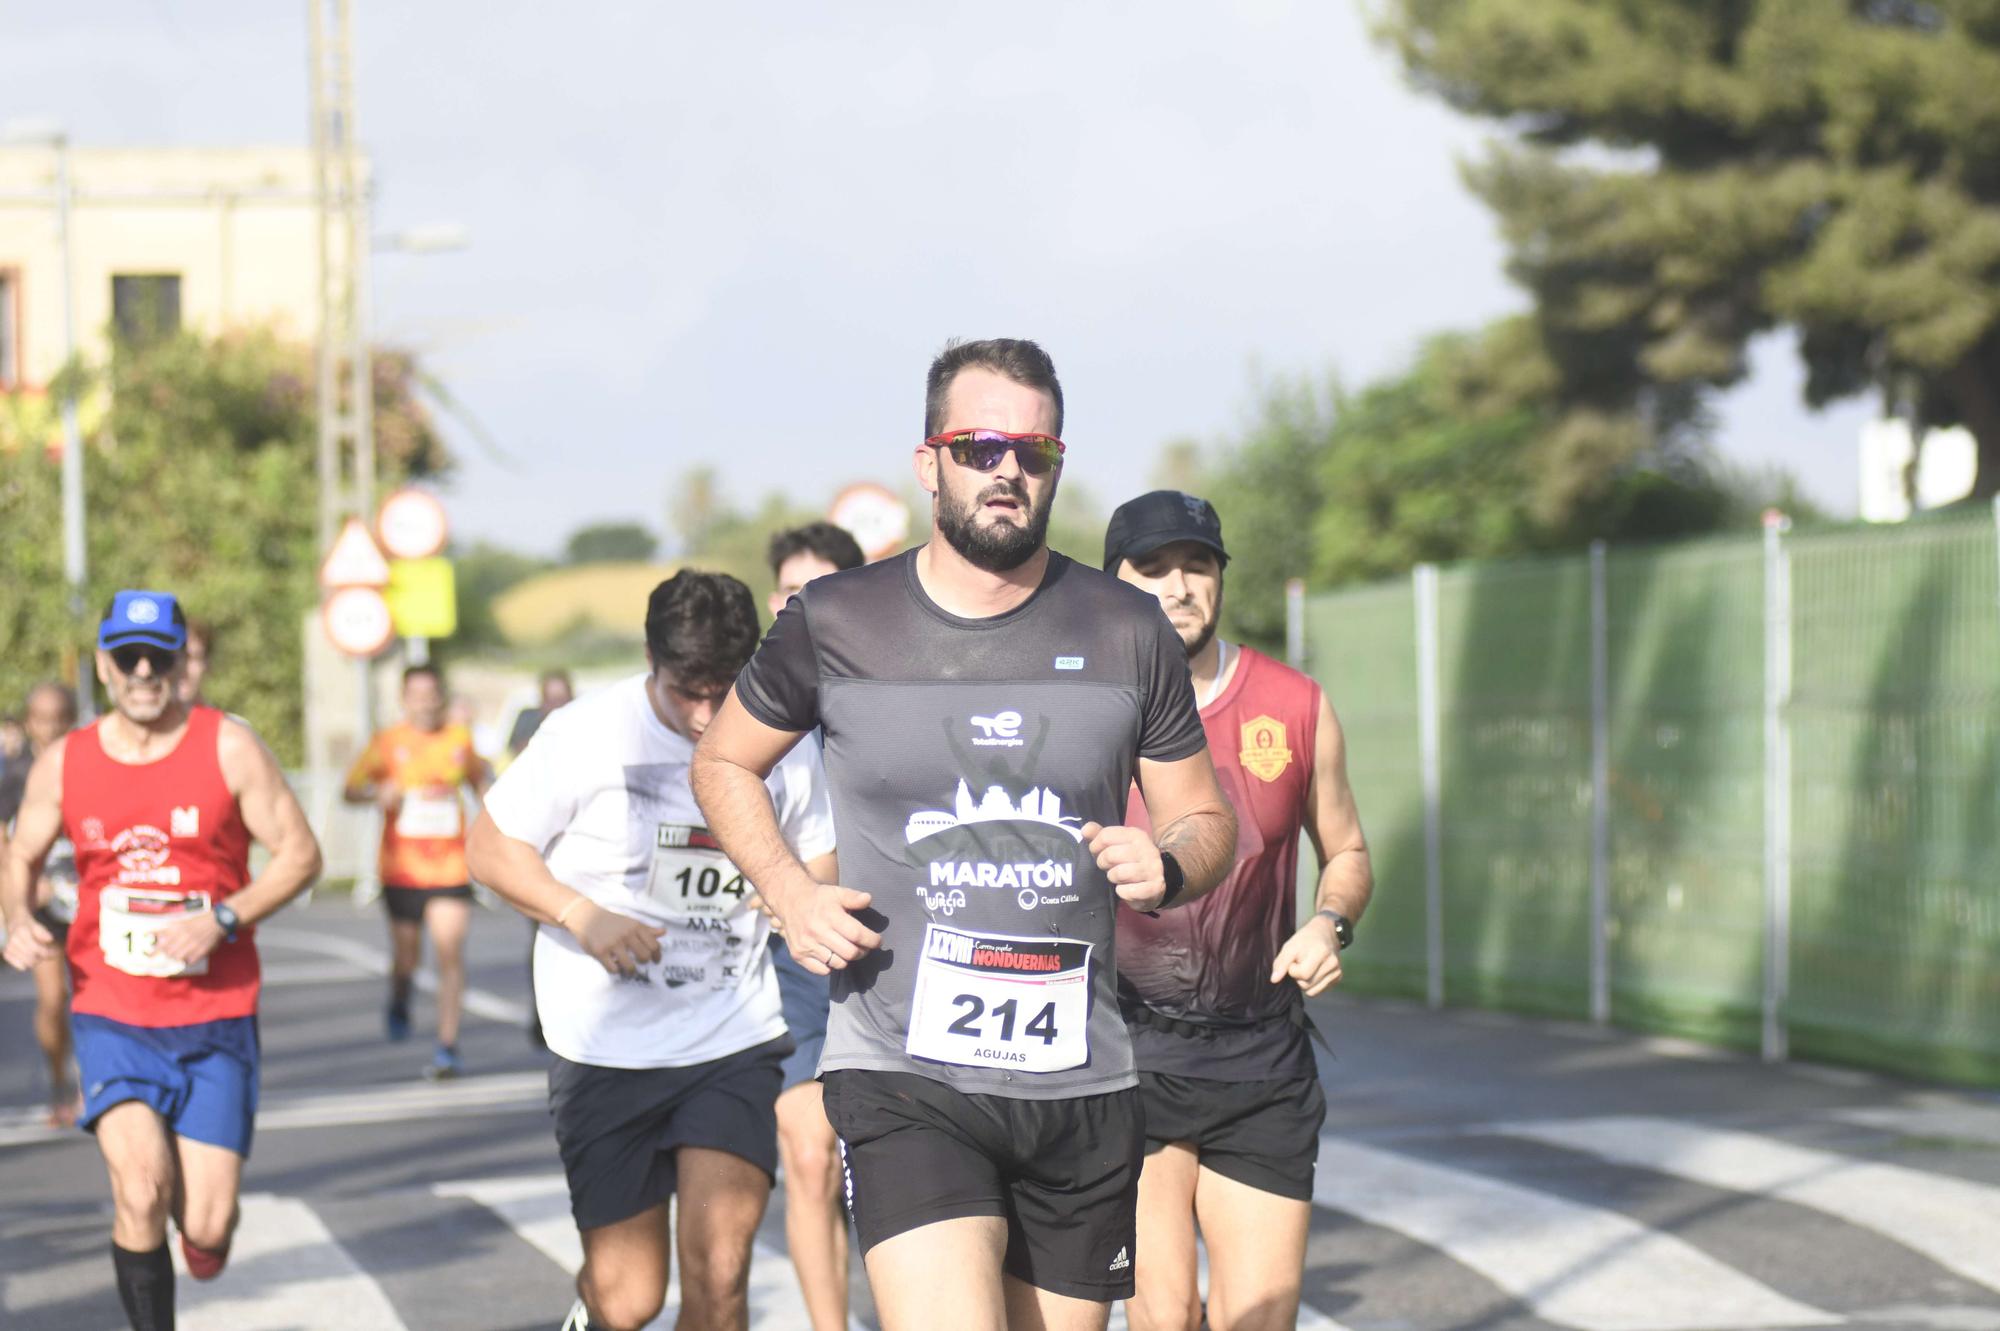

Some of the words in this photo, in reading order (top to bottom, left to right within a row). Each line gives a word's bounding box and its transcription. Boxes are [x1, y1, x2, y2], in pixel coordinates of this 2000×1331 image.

[675, 866, 745, 899] 104
[930, 859, 1072, 888] MARATÓN
[1041, 896, 1060, 905] Costa
[928, 930, 974, 965] XXVIII
[972, 950, 1061, 971] NONDUERMAS
[946, 993, 1058, 1045] 214
[973, 1048, 1027, 1062] AGUJAS
[1110, 1259, 1130, 1270] adidas
